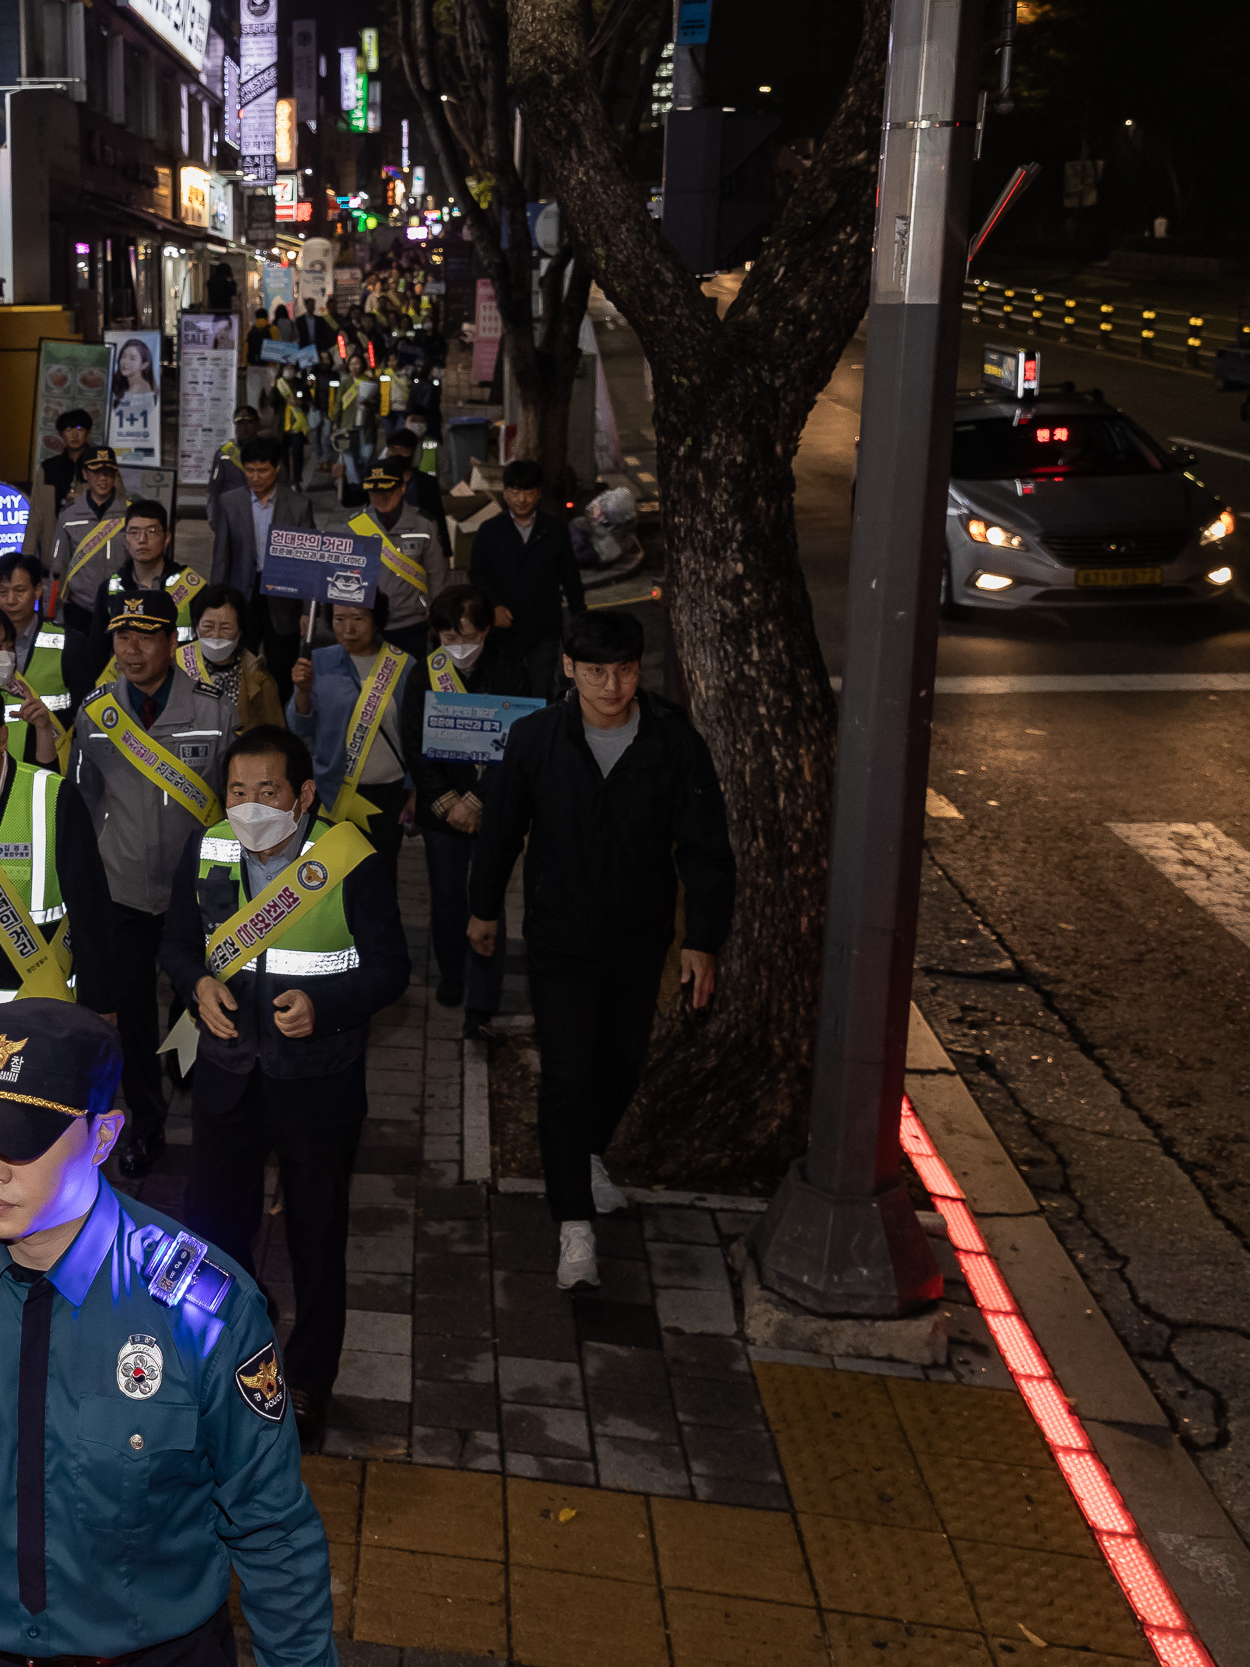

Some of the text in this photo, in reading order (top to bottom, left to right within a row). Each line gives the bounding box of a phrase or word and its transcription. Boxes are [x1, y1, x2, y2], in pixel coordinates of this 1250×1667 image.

[184, 333, 209, 346] SALE
[115, 409, 149, 430] 1+1
[271, 530, 354, 554] 건대맛의 거리!
[236, 885, 301, 949] 범죄없는
[8, 925, 39, 959] 거리
[264, 1391, 284, 1410] POLICE
